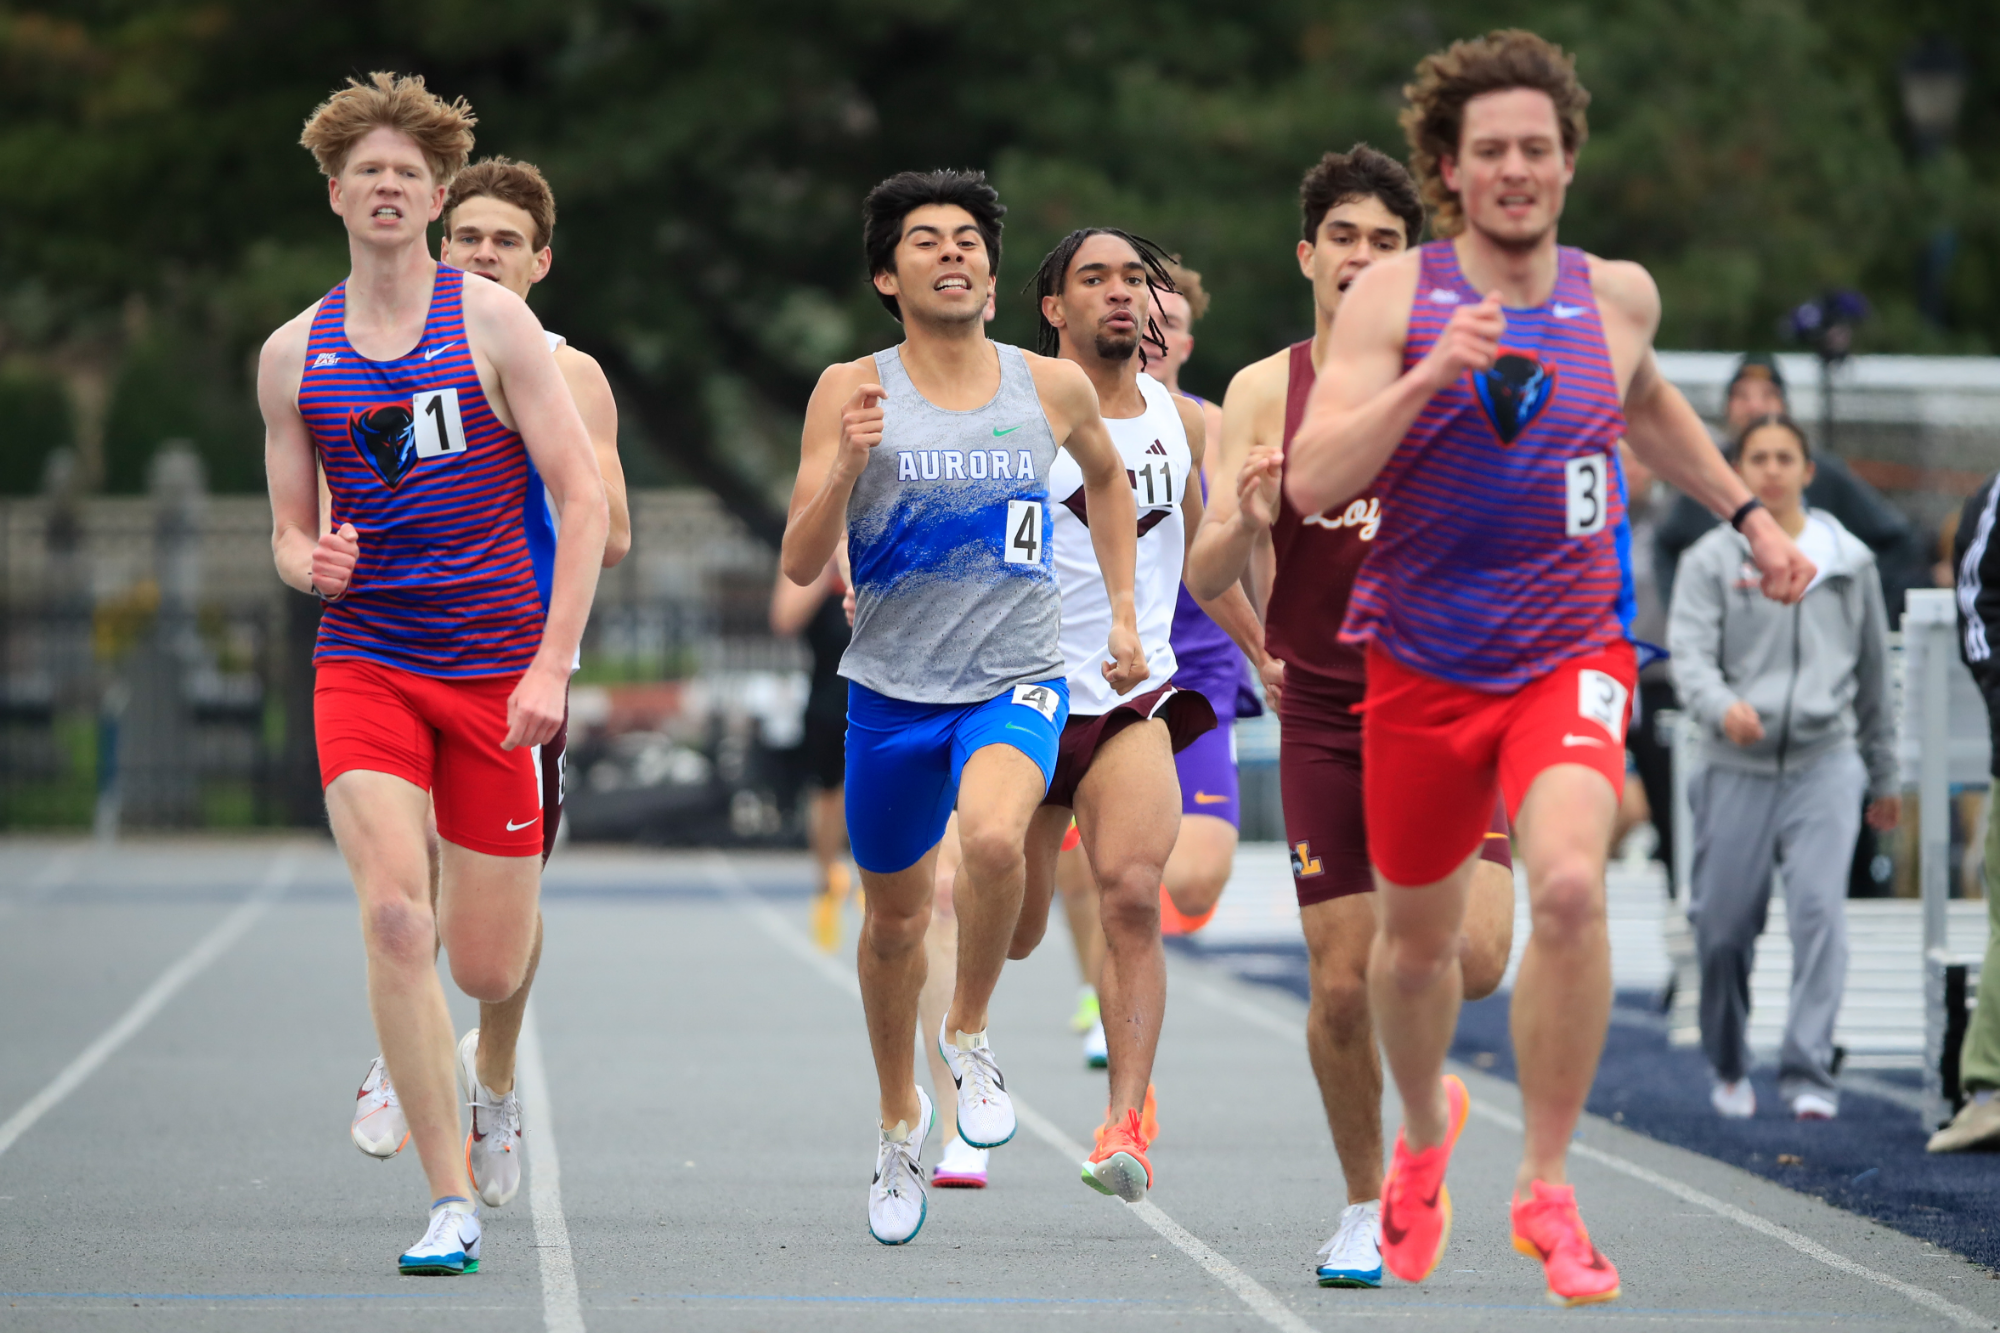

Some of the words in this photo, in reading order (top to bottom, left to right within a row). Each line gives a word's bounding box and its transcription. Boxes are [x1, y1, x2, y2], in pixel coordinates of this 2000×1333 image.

[425, 394, 450, 451] 1
[897, 450, 1036, 482] AURORA
[1138, 462, 1173, 504] 11
[1579, 465, 1598, 527] 3
[1014, 505, 1037, 561] 4
[1022, 687, 1048, 712] 4
[1296, 841, 1323, 877] L
